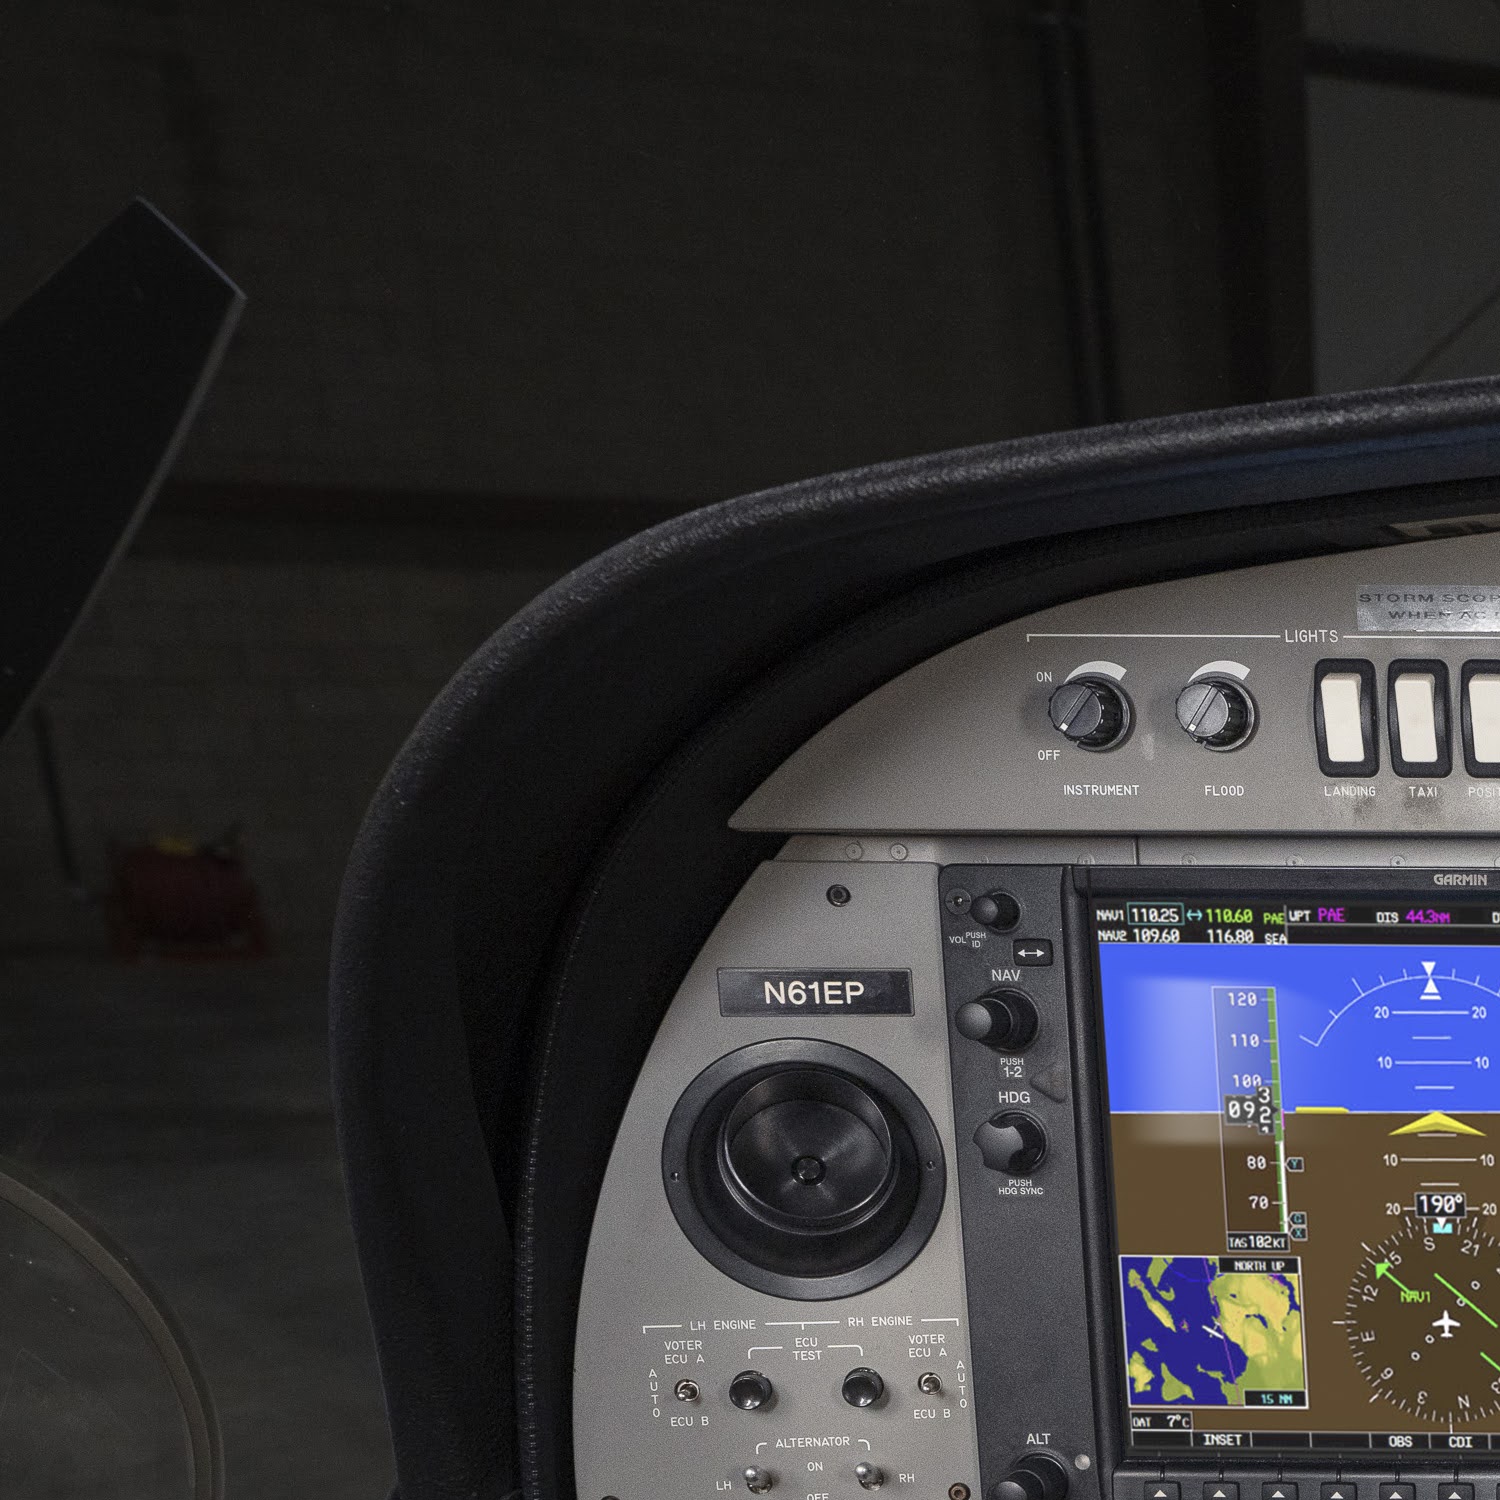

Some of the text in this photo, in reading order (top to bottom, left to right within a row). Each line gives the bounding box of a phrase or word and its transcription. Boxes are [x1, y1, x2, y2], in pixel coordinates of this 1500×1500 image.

[1359, 594, 1434, 602] STORM
[1285, 630, 1338, 643] LIGHTS
[1064, 785, 1139, 795] INSTRUMENT
[1205, 786, 1244, 796] FLOOD
[1324, 787, 1376, 798] LANDING
[1408, 787, 1438, 797] TAXI
[1434, 874, 1487, 886] GARMIN
[1131, 909, 1253, 923] 110.25 110.60
[1133, 929, 1254, 943] 109.60 116.80
[991, 970, 1020, 981] NAV
[764, 981, 864, 1005] N61EP
[1235, 1261, 1284, 1271] NORTH UP
[690, 1319, 756, 1330] LH ENGINE
[664, 1340, 702, 1350] VOTER
[775, 1436, 850, 1448] ALTERNATOR
[1204, 1435, 1242, 1446] INSET
